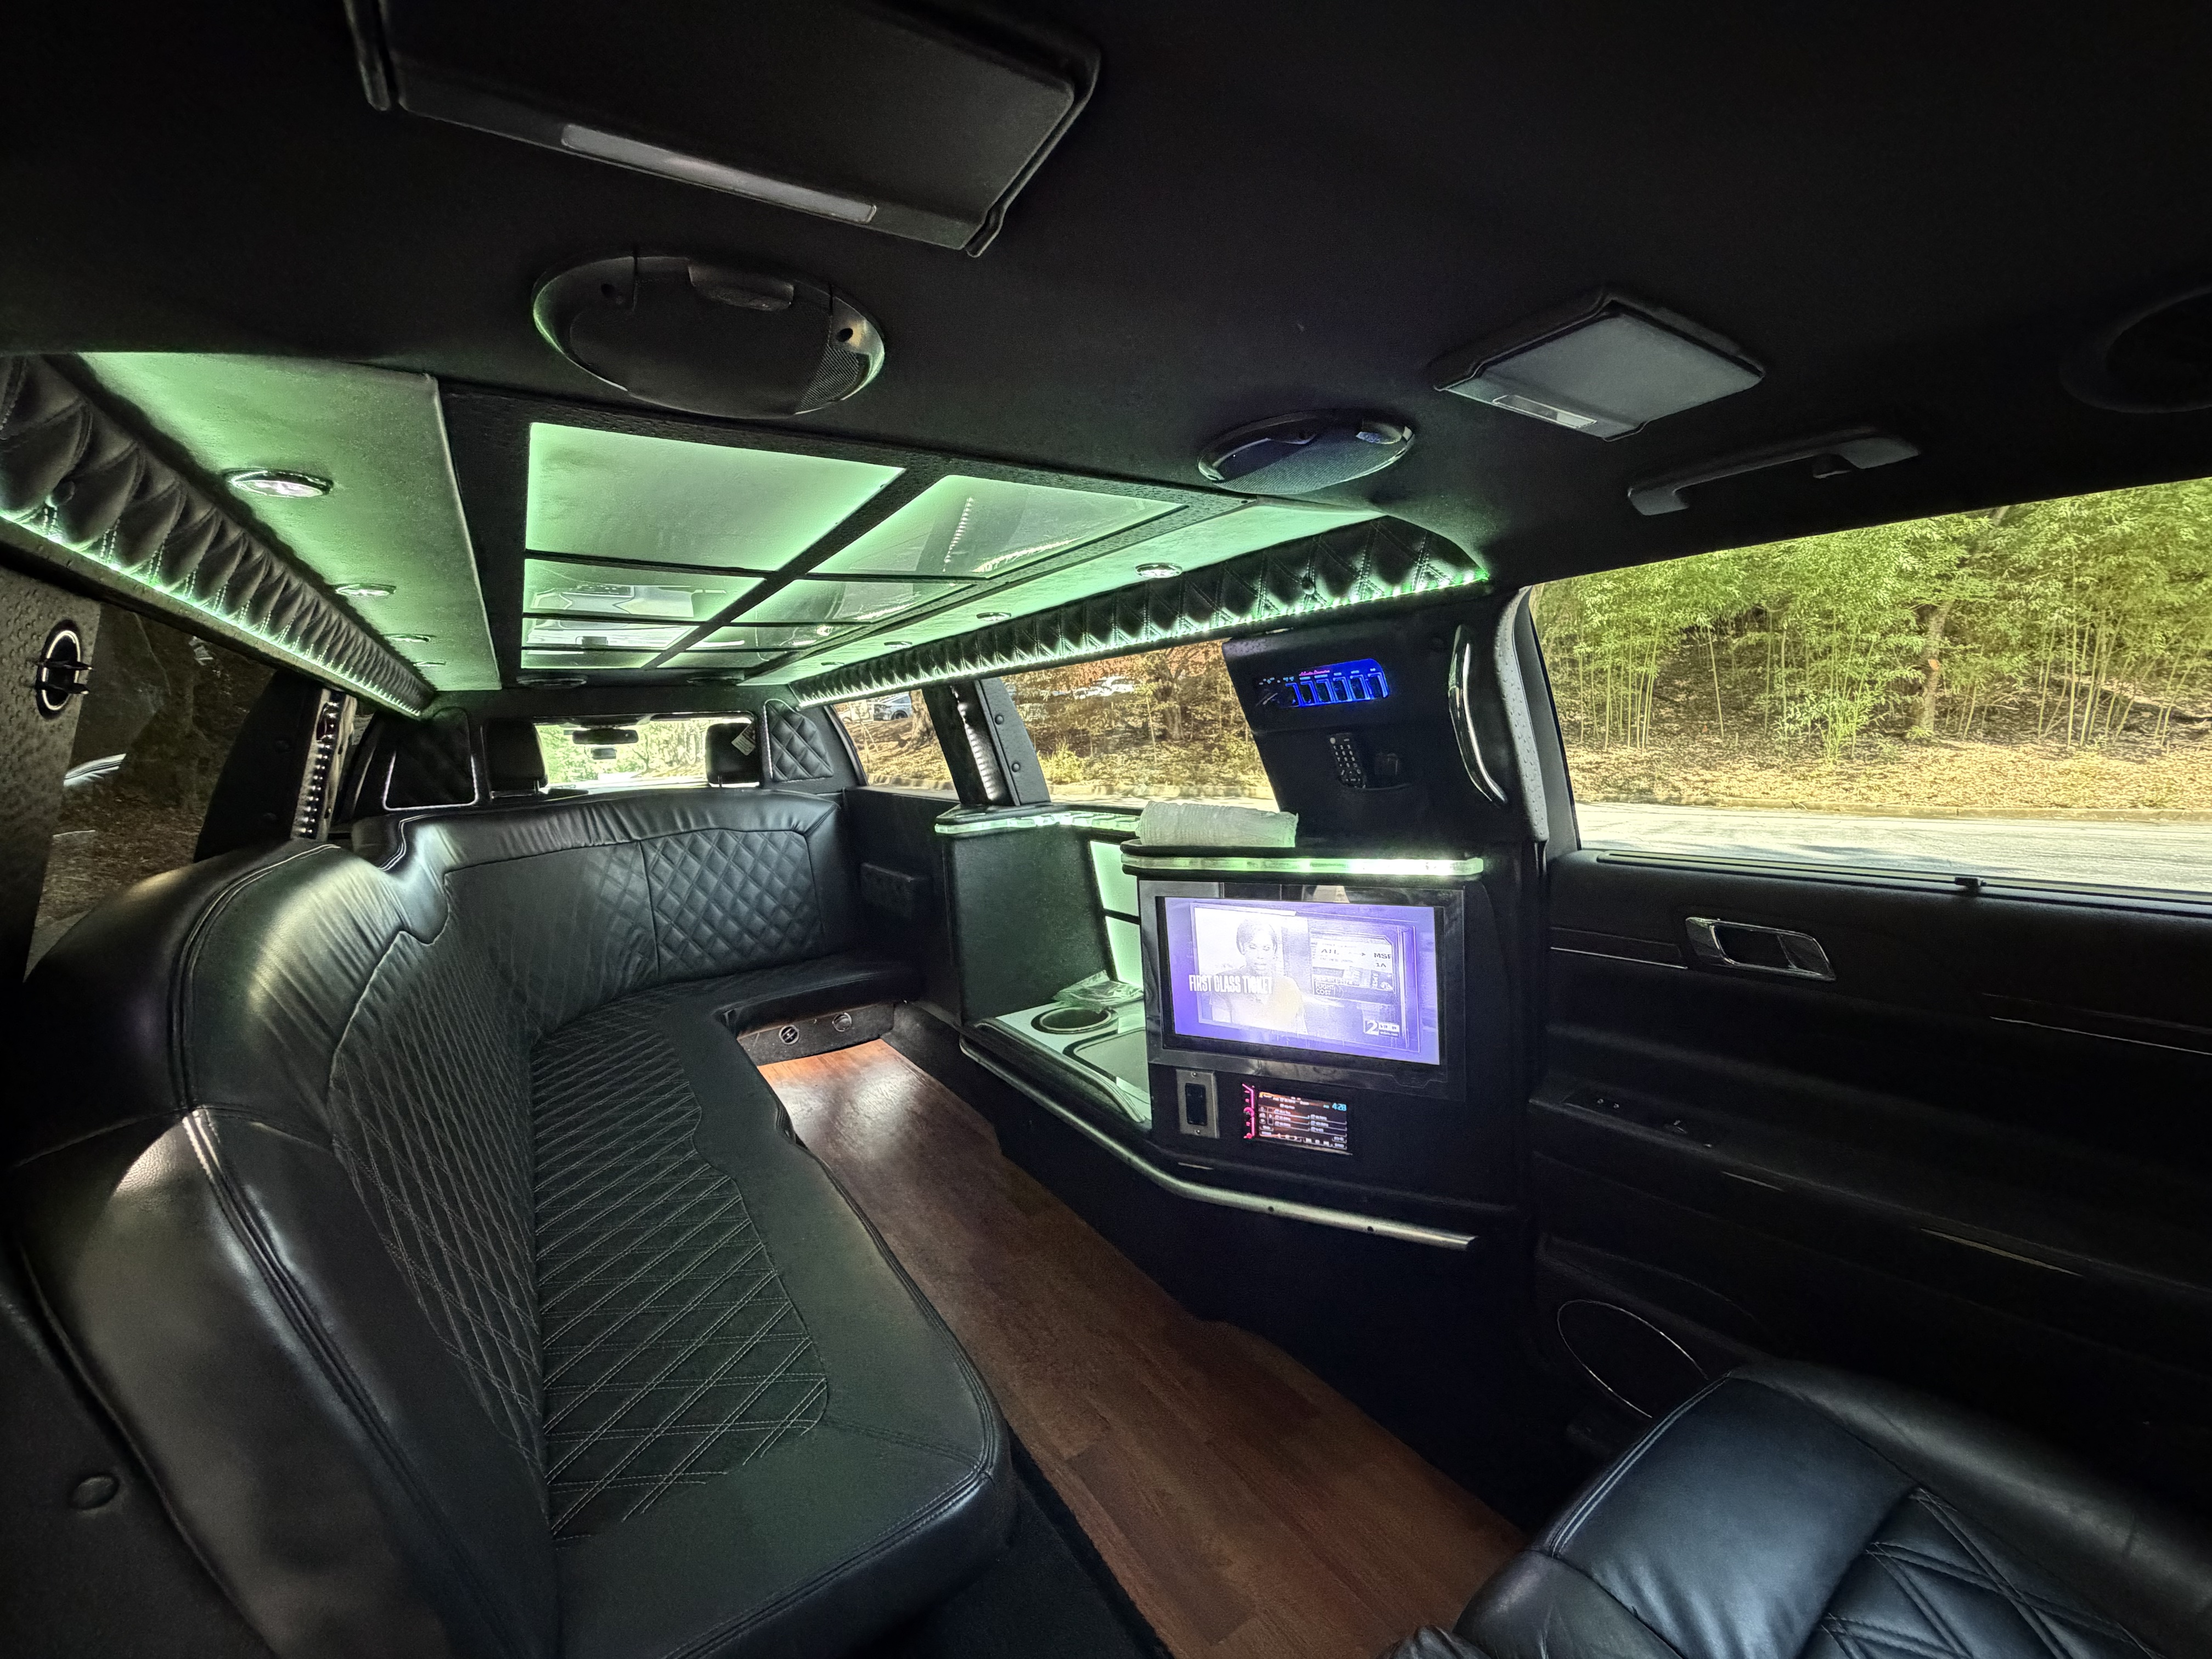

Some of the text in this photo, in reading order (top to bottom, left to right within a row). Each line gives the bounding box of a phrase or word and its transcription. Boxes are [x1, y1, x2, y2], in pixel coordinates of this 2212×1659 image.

[1189, 975, 1273, 994] FIRST CLASS TICKET
[1365, 1020, 1379, 1036] 2
[1332, 1103, 1347, 1111] 4:28
